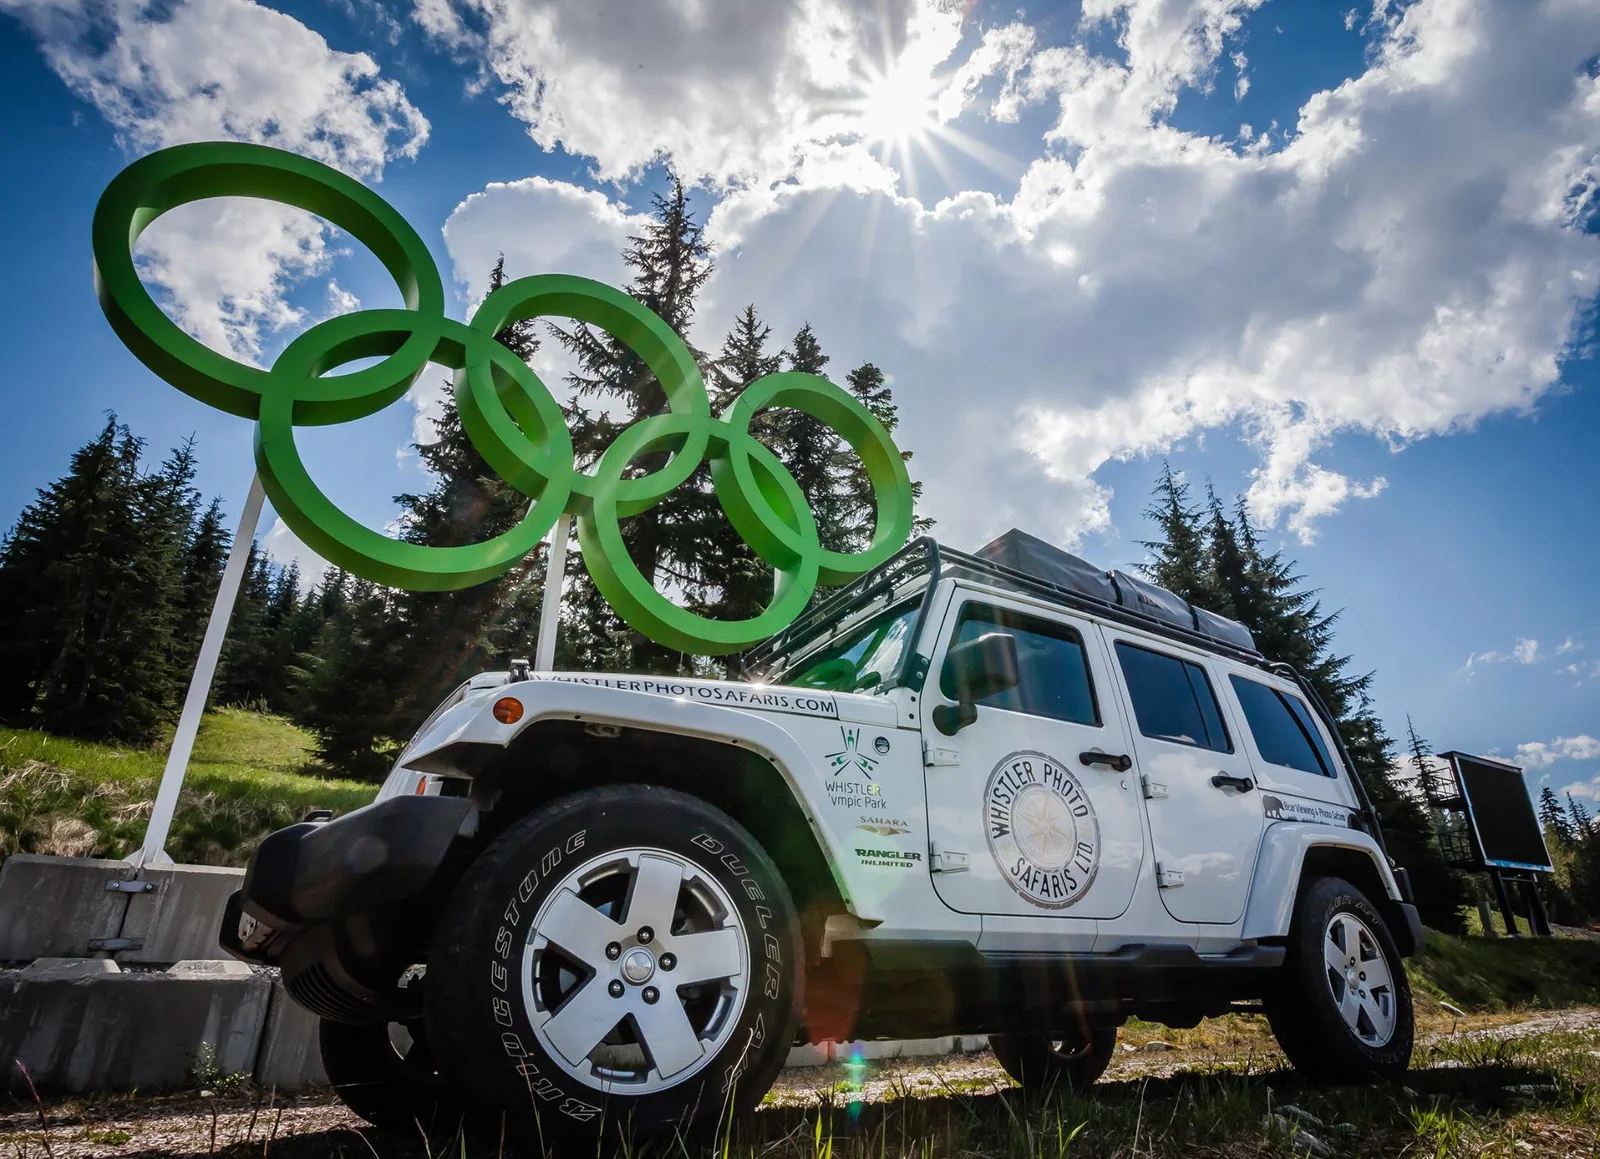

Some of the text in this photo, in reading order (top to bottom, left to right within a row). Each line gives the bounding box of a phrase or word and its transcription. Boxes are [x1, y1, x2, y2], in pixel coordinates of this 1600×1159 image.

[825, 780, 882, 796] WHISTLER
[865, 796, 887, 809] Park
[991, 761, 1089, 839] WHISTLER PHOTO
[860, 816, 909, 827] SAHARA
[1010, 856, 1078, 899] SAFARIS
[690, 833, 781, 1000] DUELER
[490, 829, 602, 1122] BRIDGESTONE
